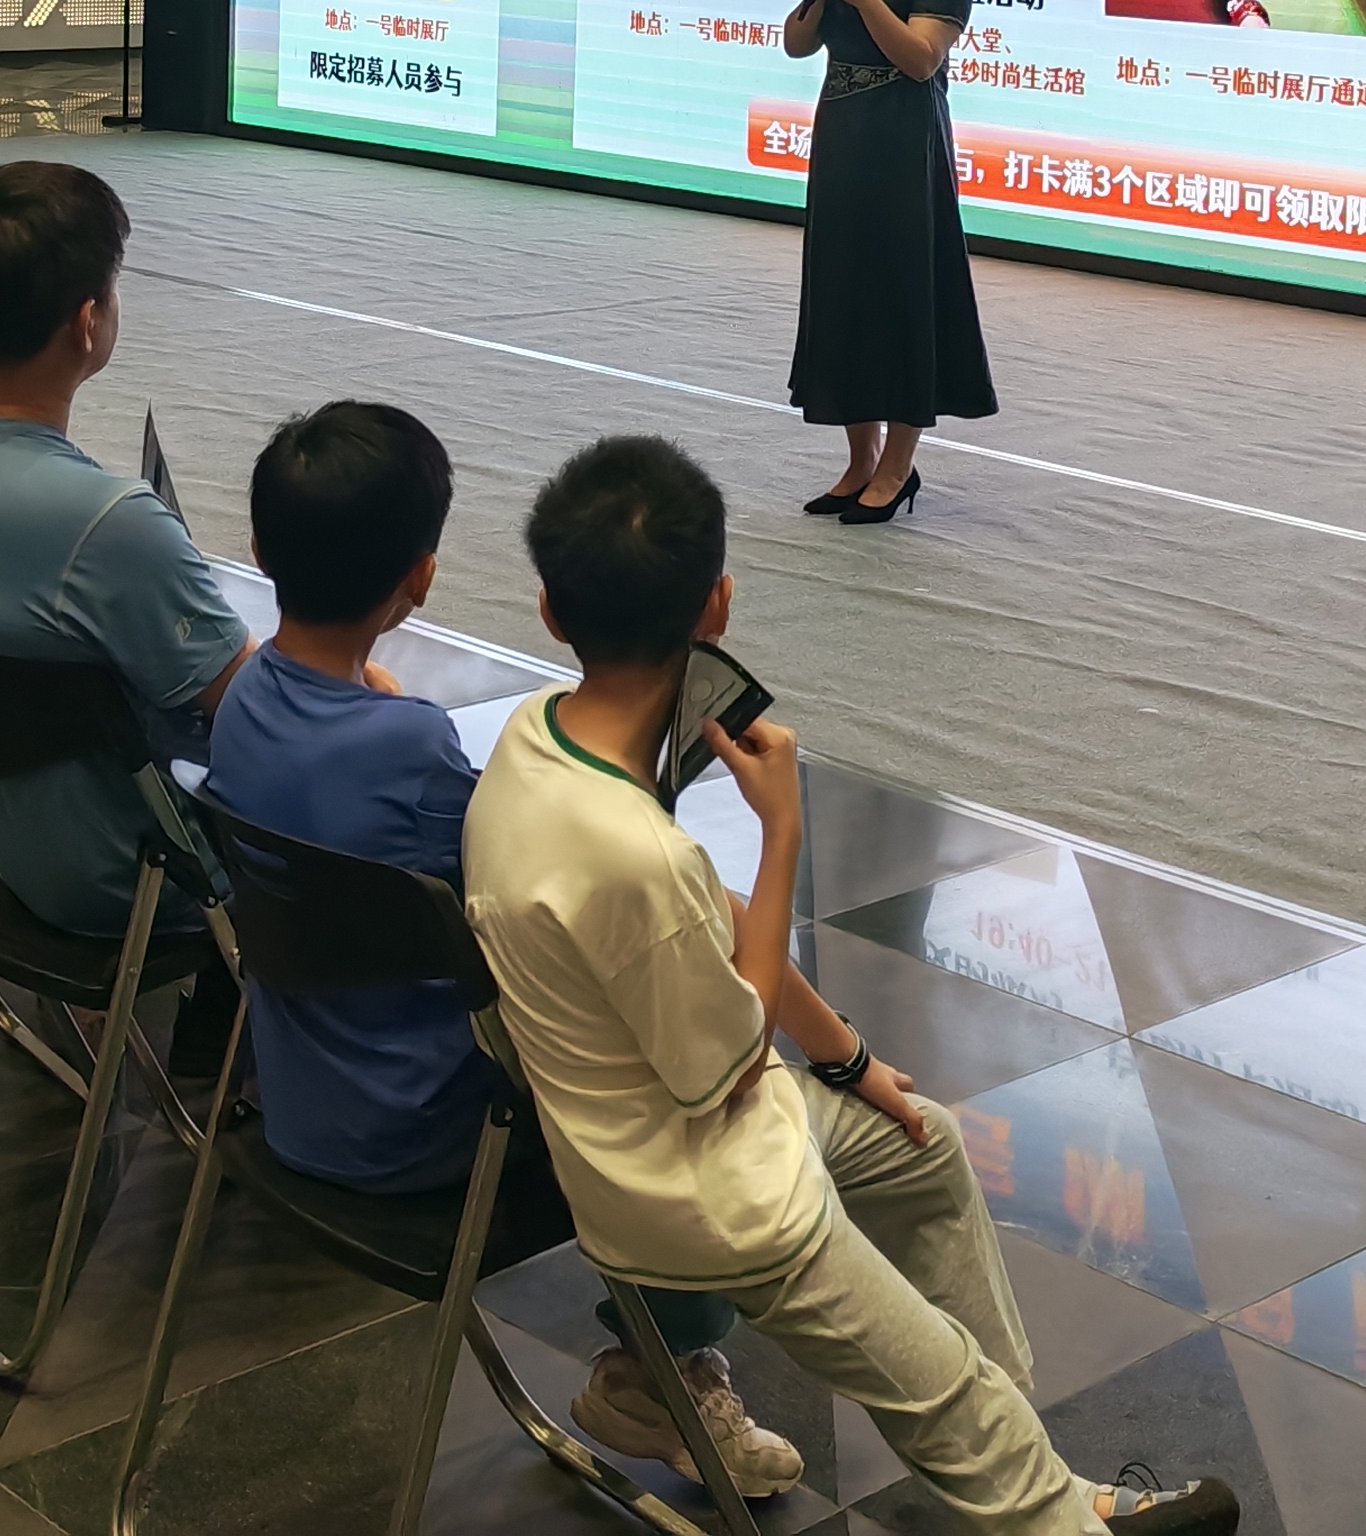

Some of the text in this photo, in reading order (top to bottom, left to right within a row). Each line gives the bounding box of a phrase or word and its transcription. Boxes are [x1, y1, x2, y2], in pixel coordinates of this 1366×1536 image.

[310, 51, 462, 97] 限定招募人员参与
